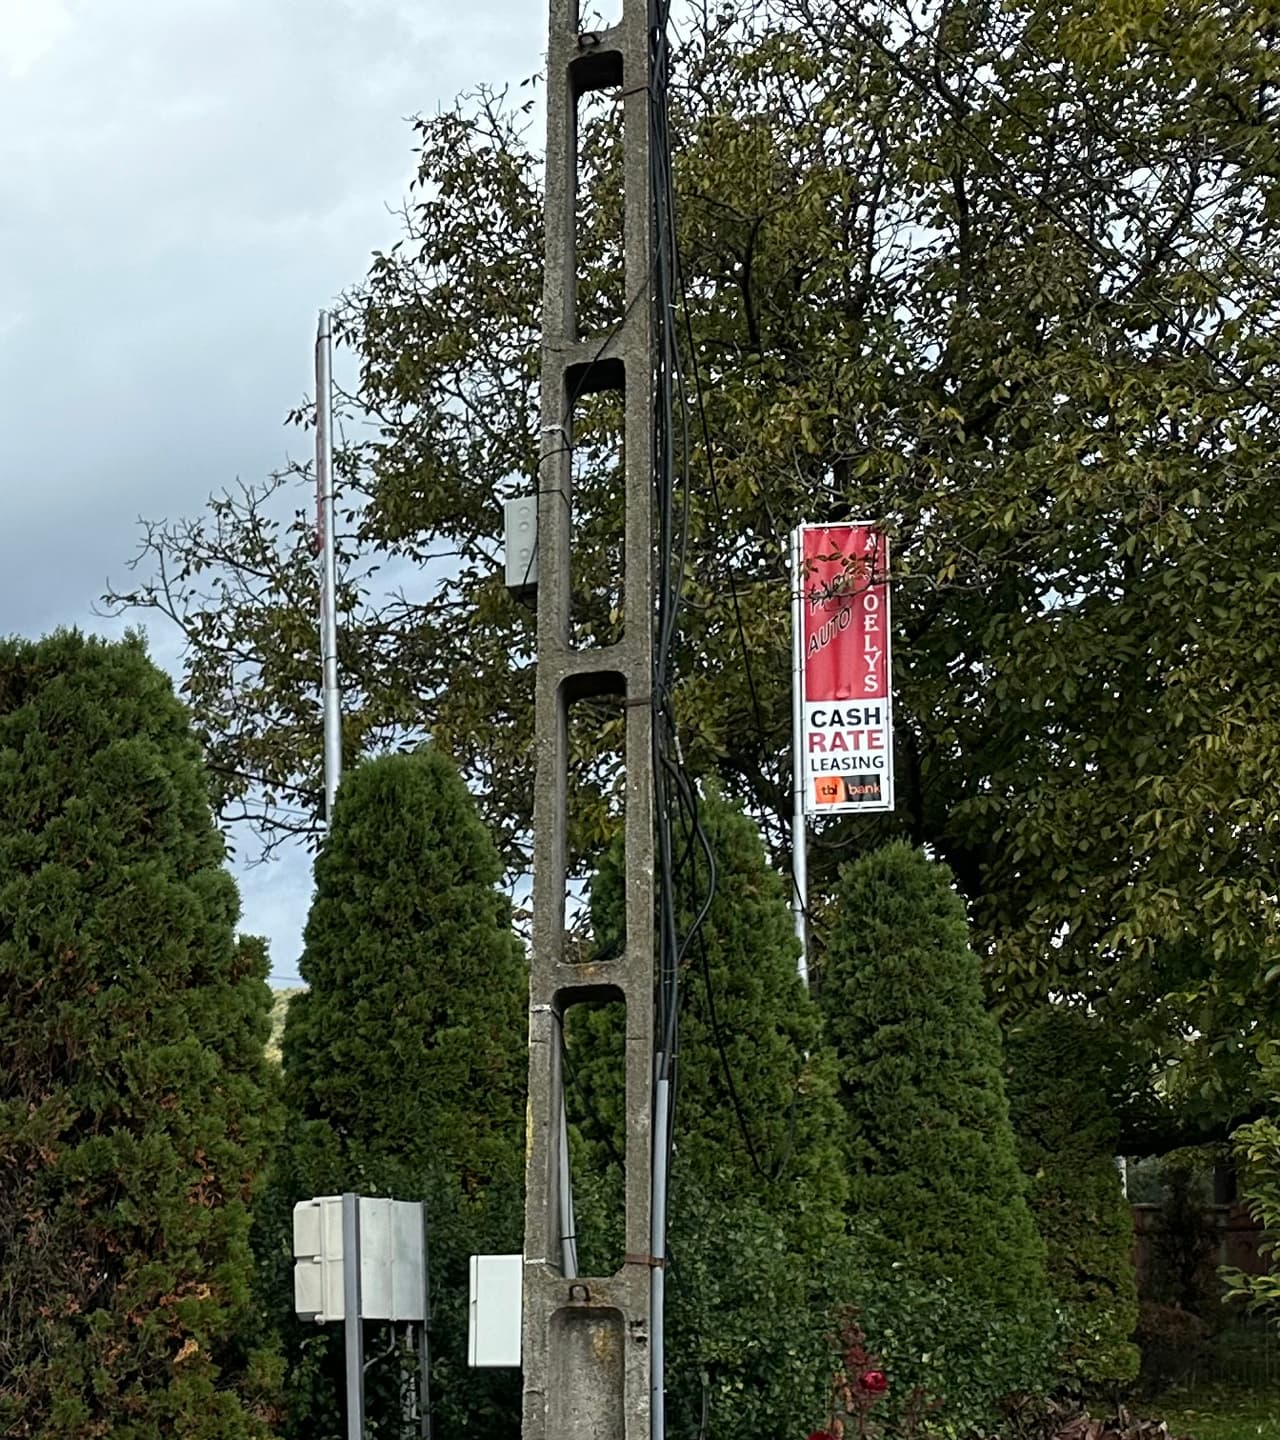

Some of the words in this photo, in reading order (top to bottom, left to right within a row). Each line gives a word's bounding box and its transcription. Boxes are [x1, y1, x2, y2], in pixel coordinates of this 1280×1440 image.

[863, 532, 883, 693] AOELYS
[808, 606, 852, 659] AUTO
[810, 707, 881, 728] CASH
[808, 730, 885, 753] RATE
[811, 755, 885, 772] LEASING
